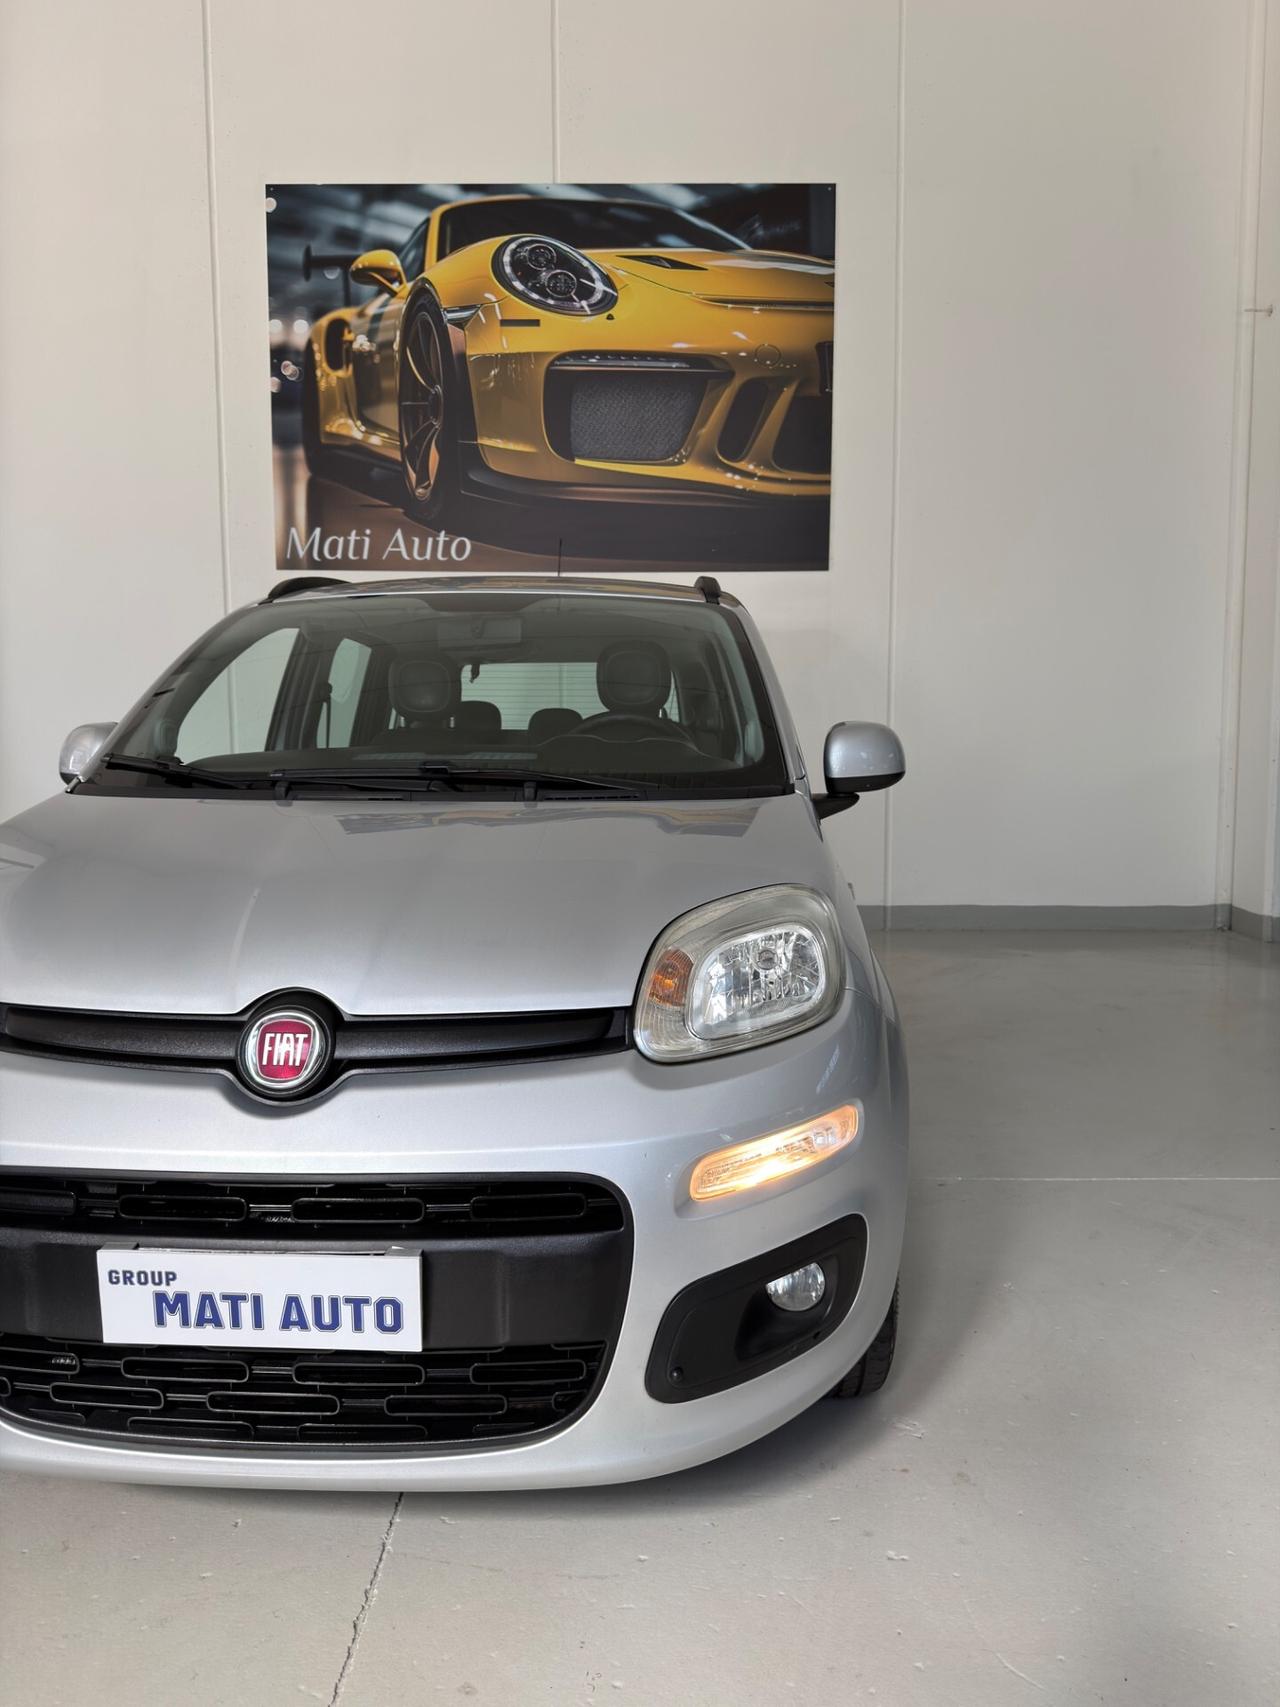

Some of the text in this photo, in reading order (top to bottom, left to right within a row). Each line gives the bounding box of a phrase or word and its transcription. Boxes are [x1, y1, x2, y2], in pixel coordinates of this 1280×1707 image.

[286, 526, 472, 561] Mati Auto
[262, 1032, 309, 1067] FIAT
[107, 1269, 178, 1287] GROUP
[152, 1290, 405, 1335] MATI AUTO
